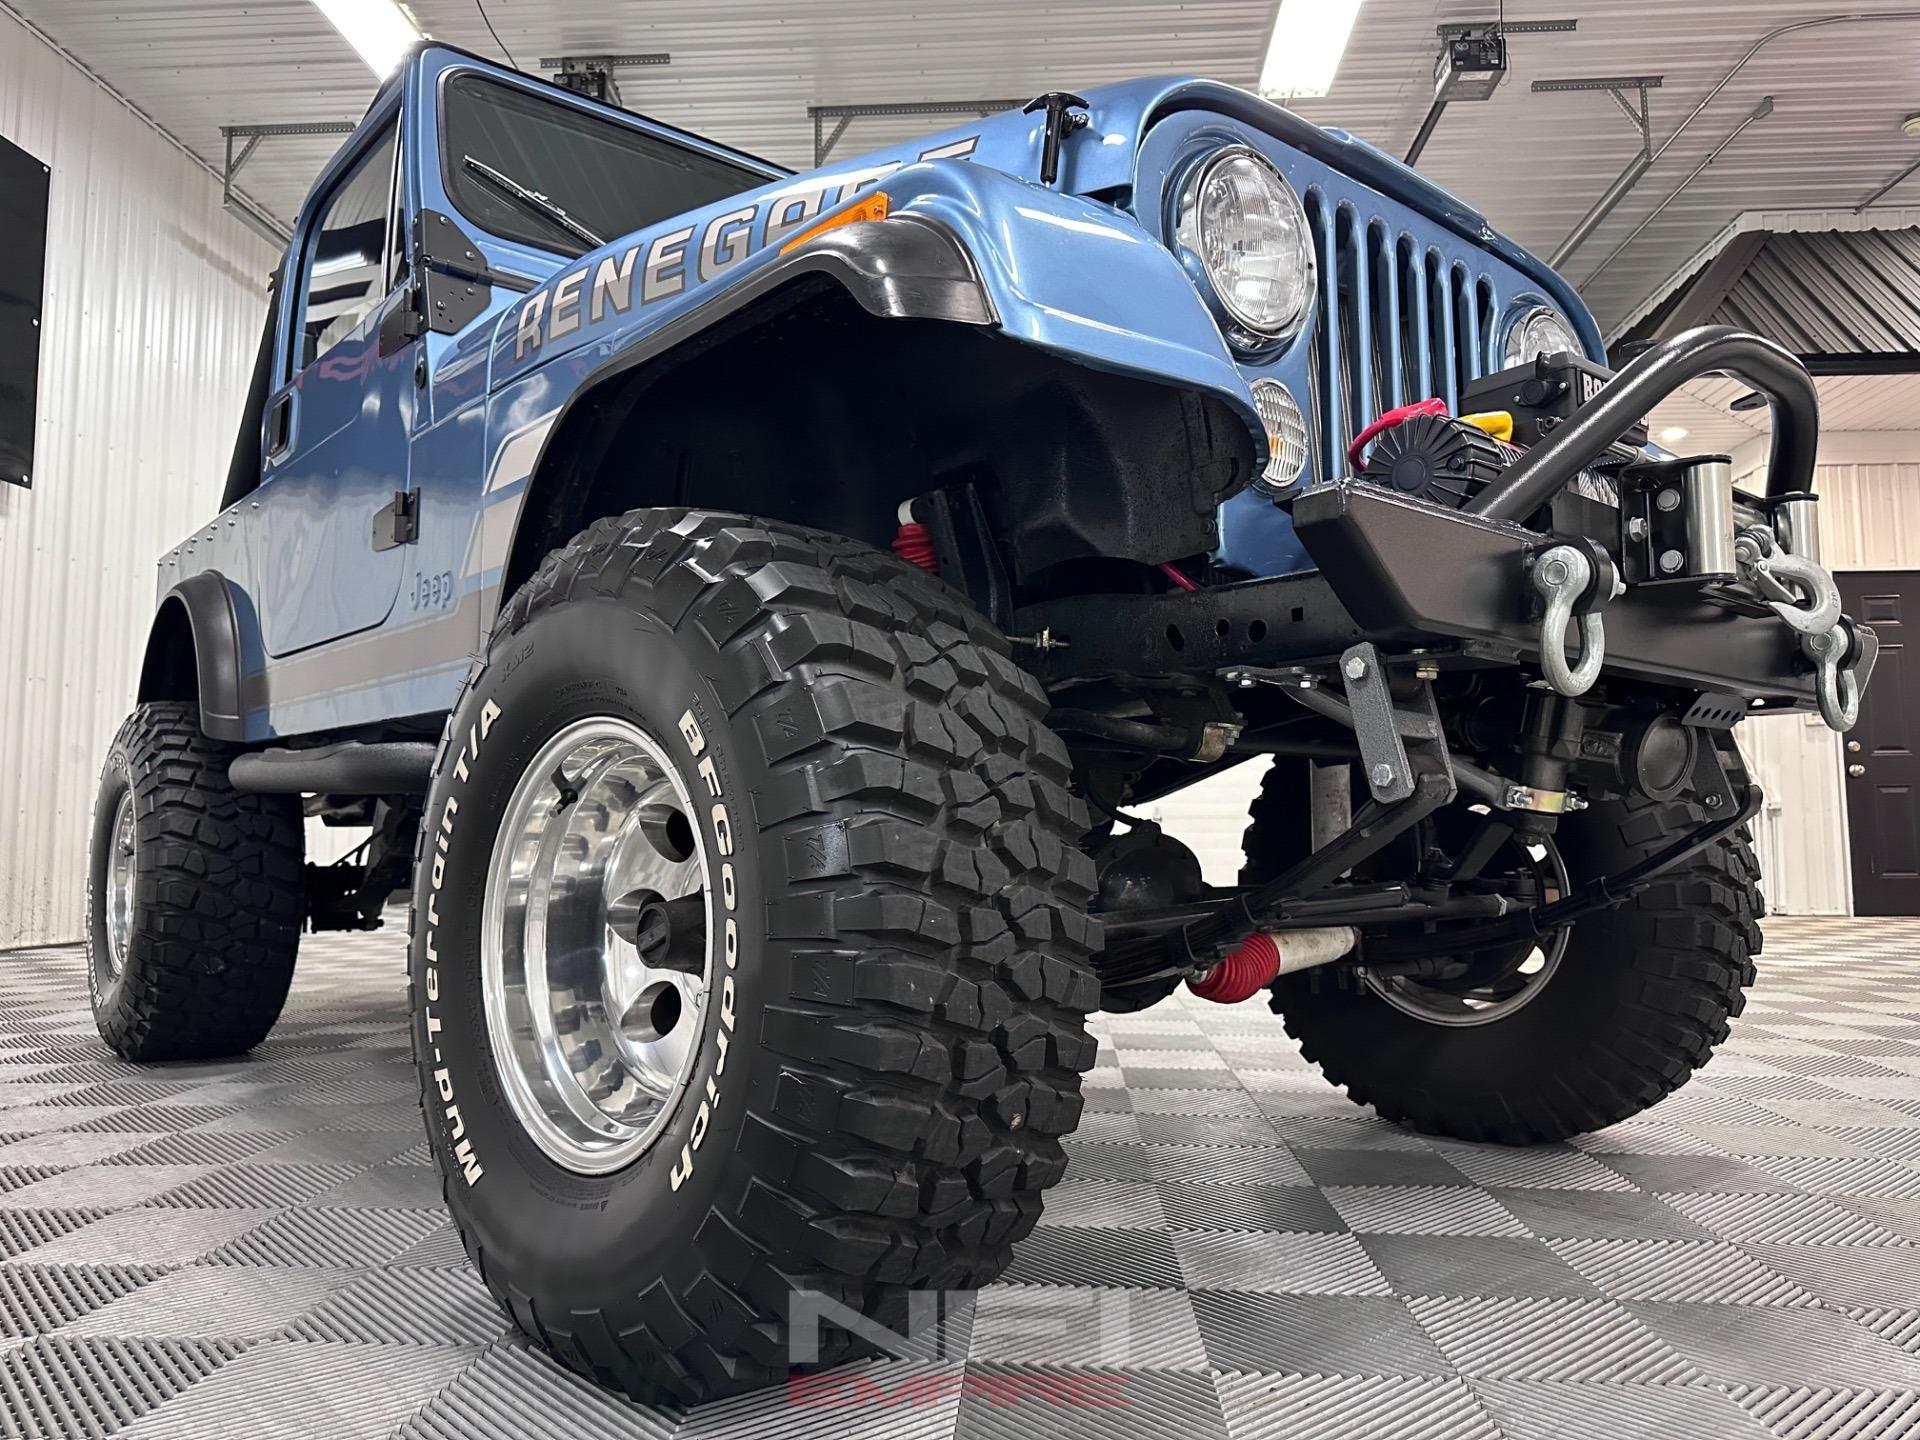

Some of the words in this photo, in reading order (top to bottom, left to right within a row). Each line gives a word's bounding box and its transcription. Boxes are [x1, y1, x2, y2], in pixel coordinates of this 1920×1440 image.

[513, 134, 981, 364] RENEGA
[410, 570, 454, 611] Jeep
[453, 697, 502, 783] T/A
[425, 796, 485, 1188] Mud-Terrain
[669, 708, 739, 1192] BFGoodrich
